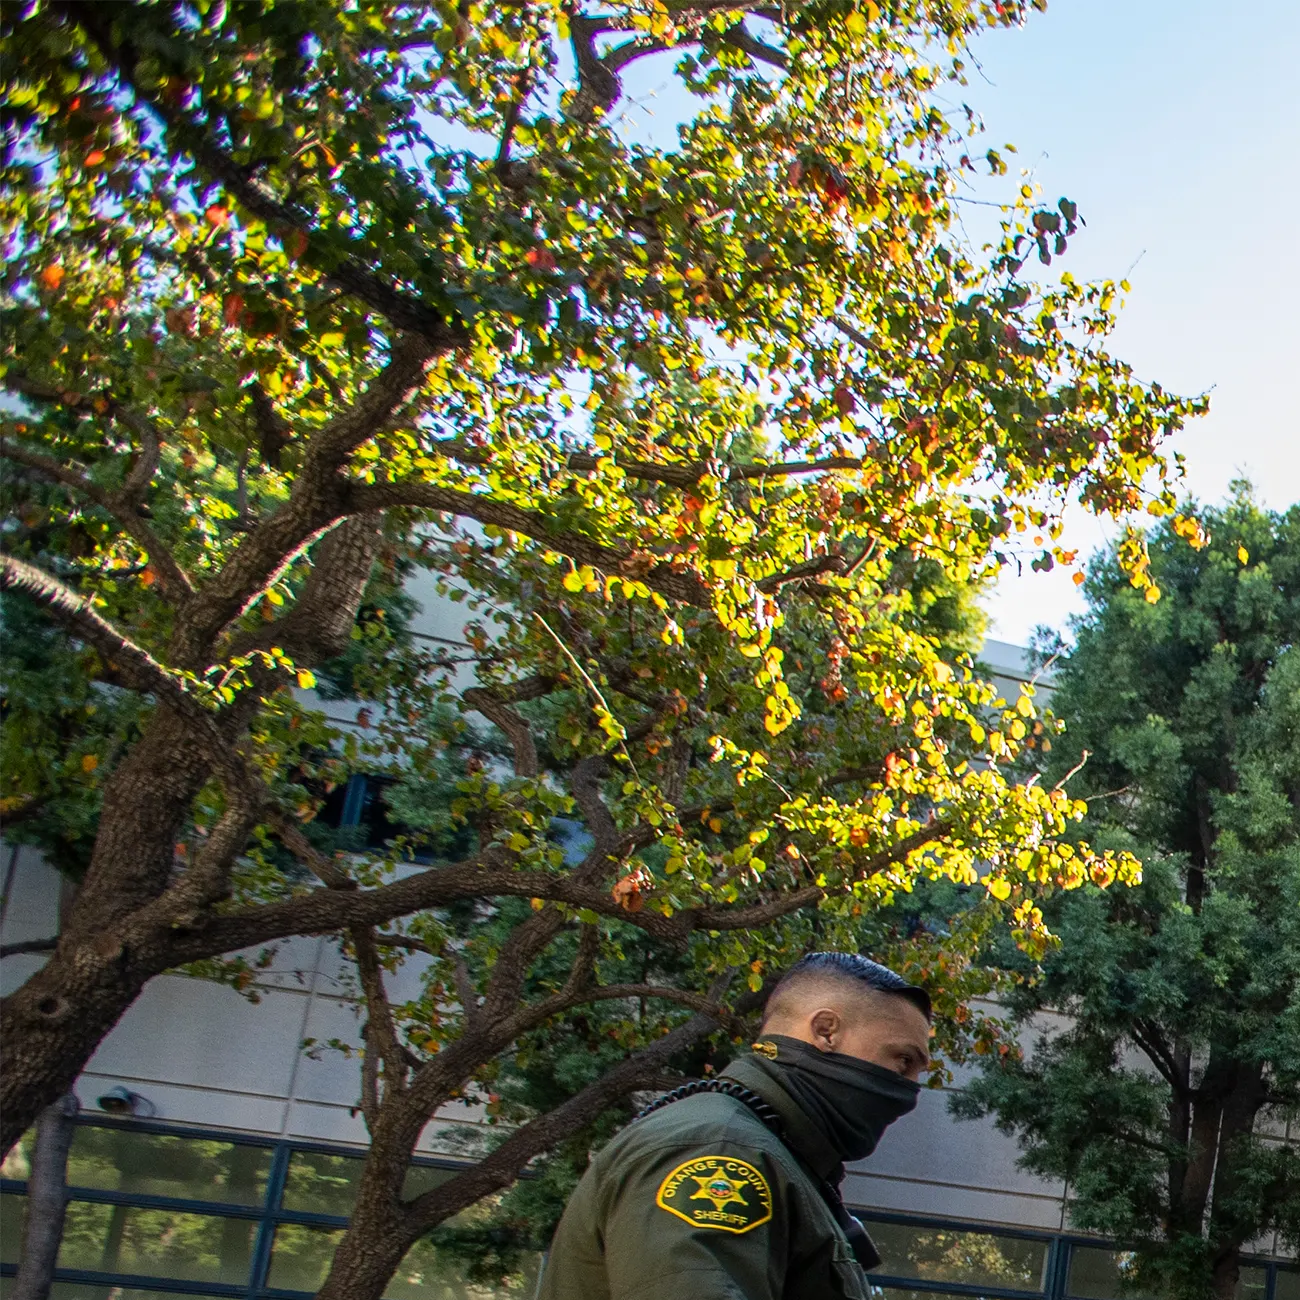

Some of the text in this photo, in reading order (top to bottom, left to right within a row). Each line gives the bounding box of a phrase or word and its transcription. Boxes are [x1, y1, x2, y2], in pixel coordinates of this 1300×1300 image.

[664, 1160, 771, 1209] ORANGE COUNTY
[693, 1210, 748, 1225] SHERIFF
